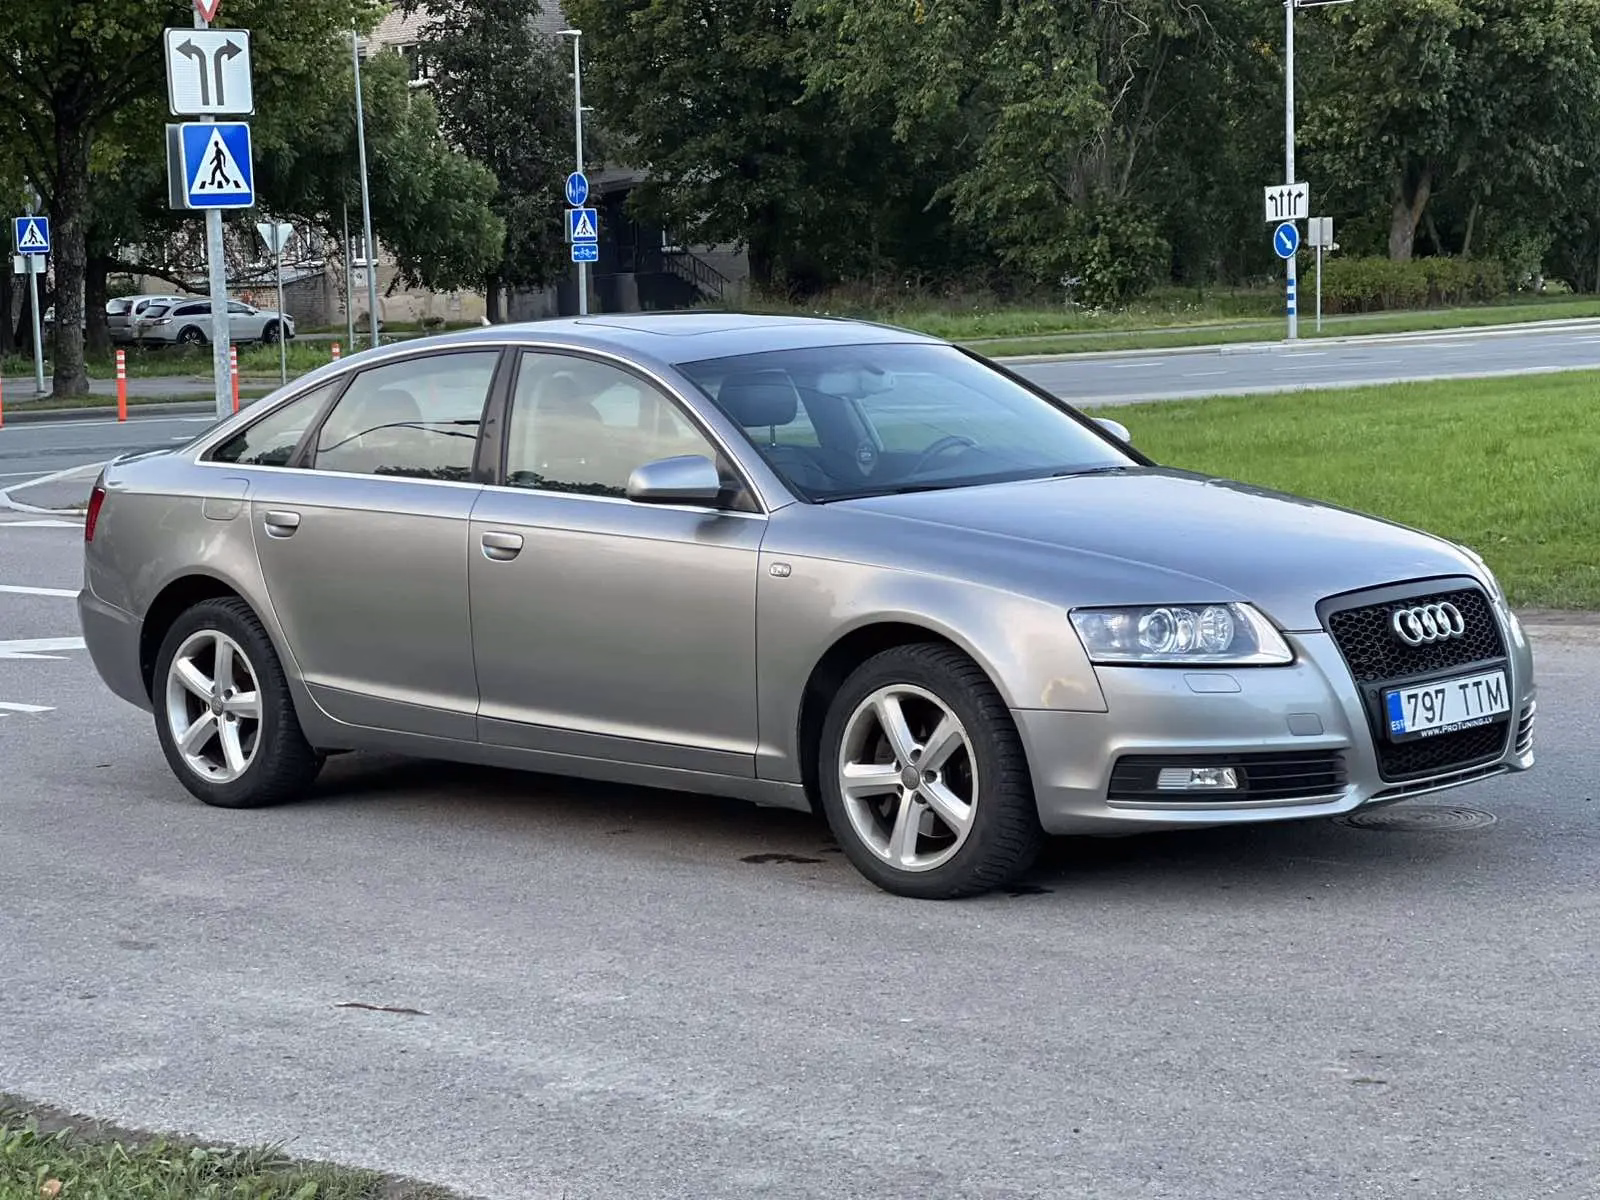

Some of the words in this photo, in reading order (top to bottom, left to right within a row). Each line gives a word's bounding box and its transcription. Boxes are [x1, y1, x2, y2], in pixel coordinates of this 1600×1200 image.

[1407, 688, 1445, 727] 797
[1458, 677, 1504, 716] TTM
[1391, 720, 1405, 731] EST
